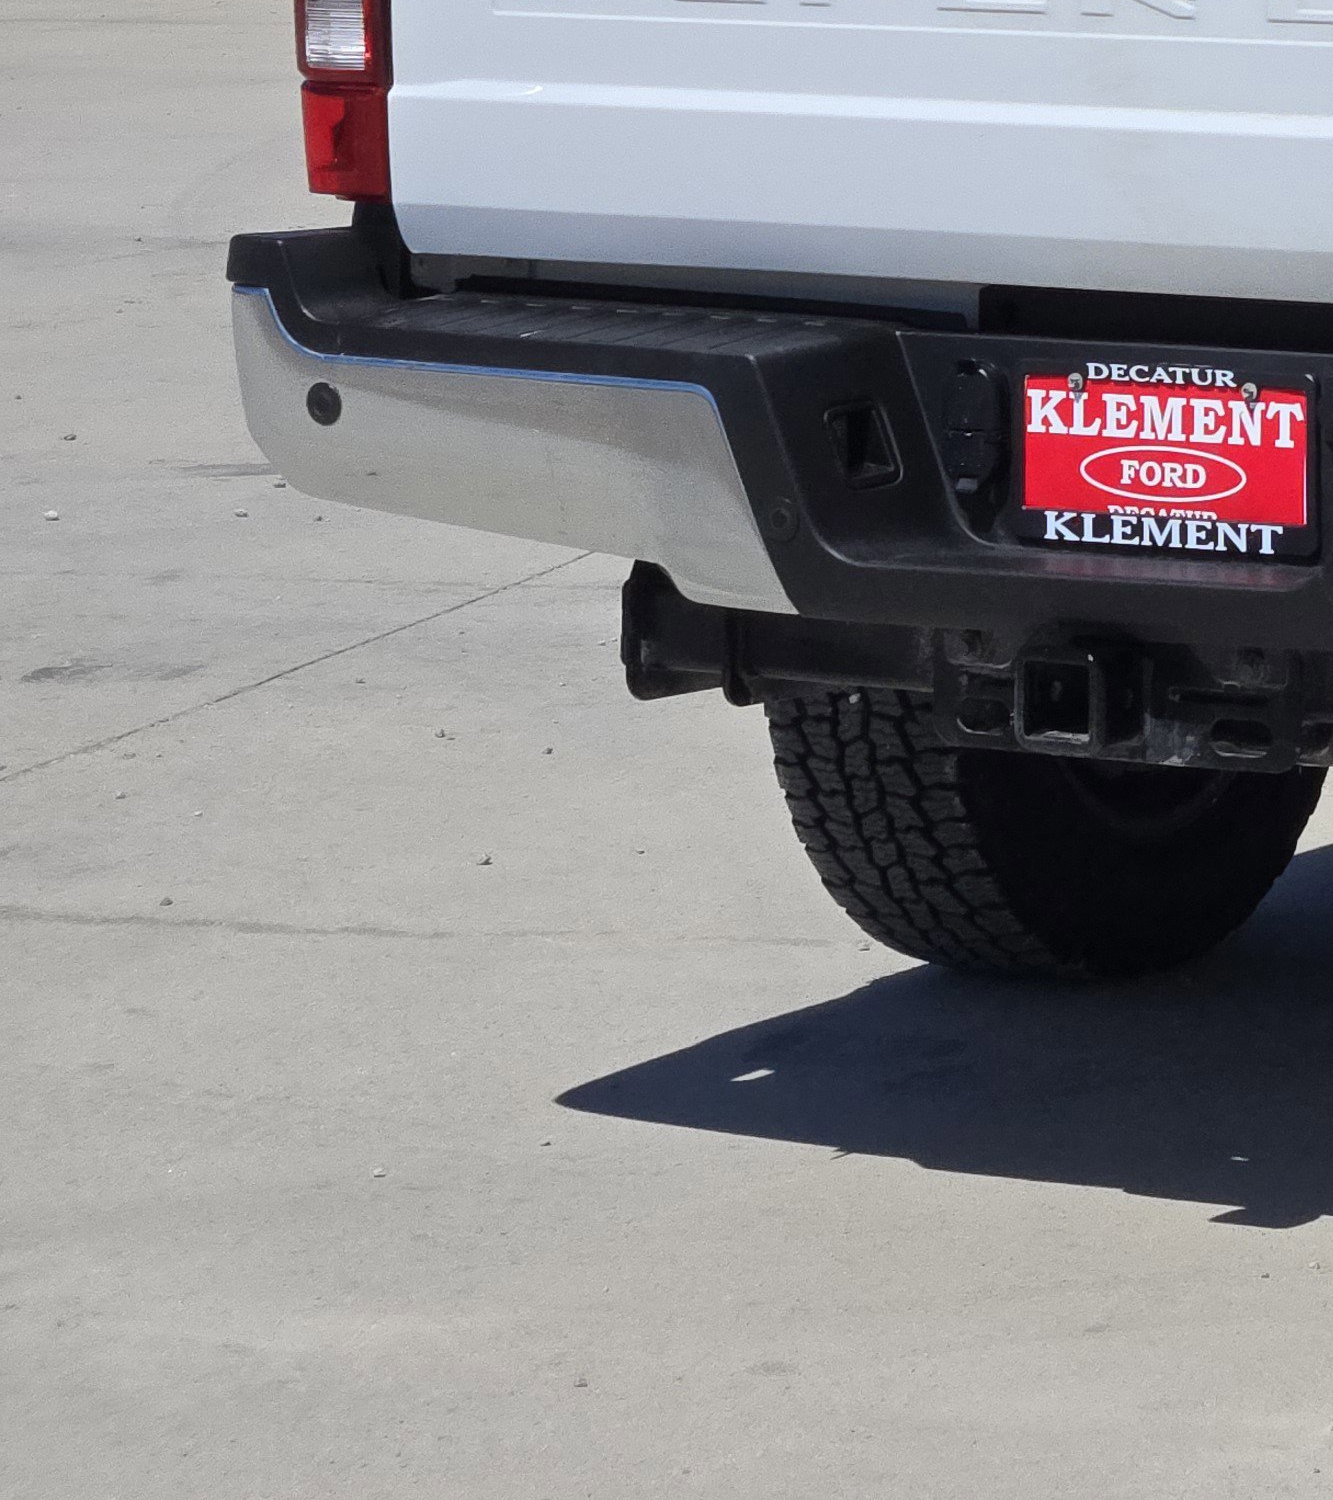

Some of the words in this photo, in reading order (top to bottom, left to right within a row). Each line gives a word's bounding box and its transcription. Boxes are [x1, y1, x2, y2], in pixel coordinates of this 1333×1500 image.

[1086, 362, 1237, 388] DECATUR
[1026, 388, 1305, 449] KLEMENT
[1120, 458, 1207, 489] FORD
[1043, 510, 1283, 555] KLEMENT
